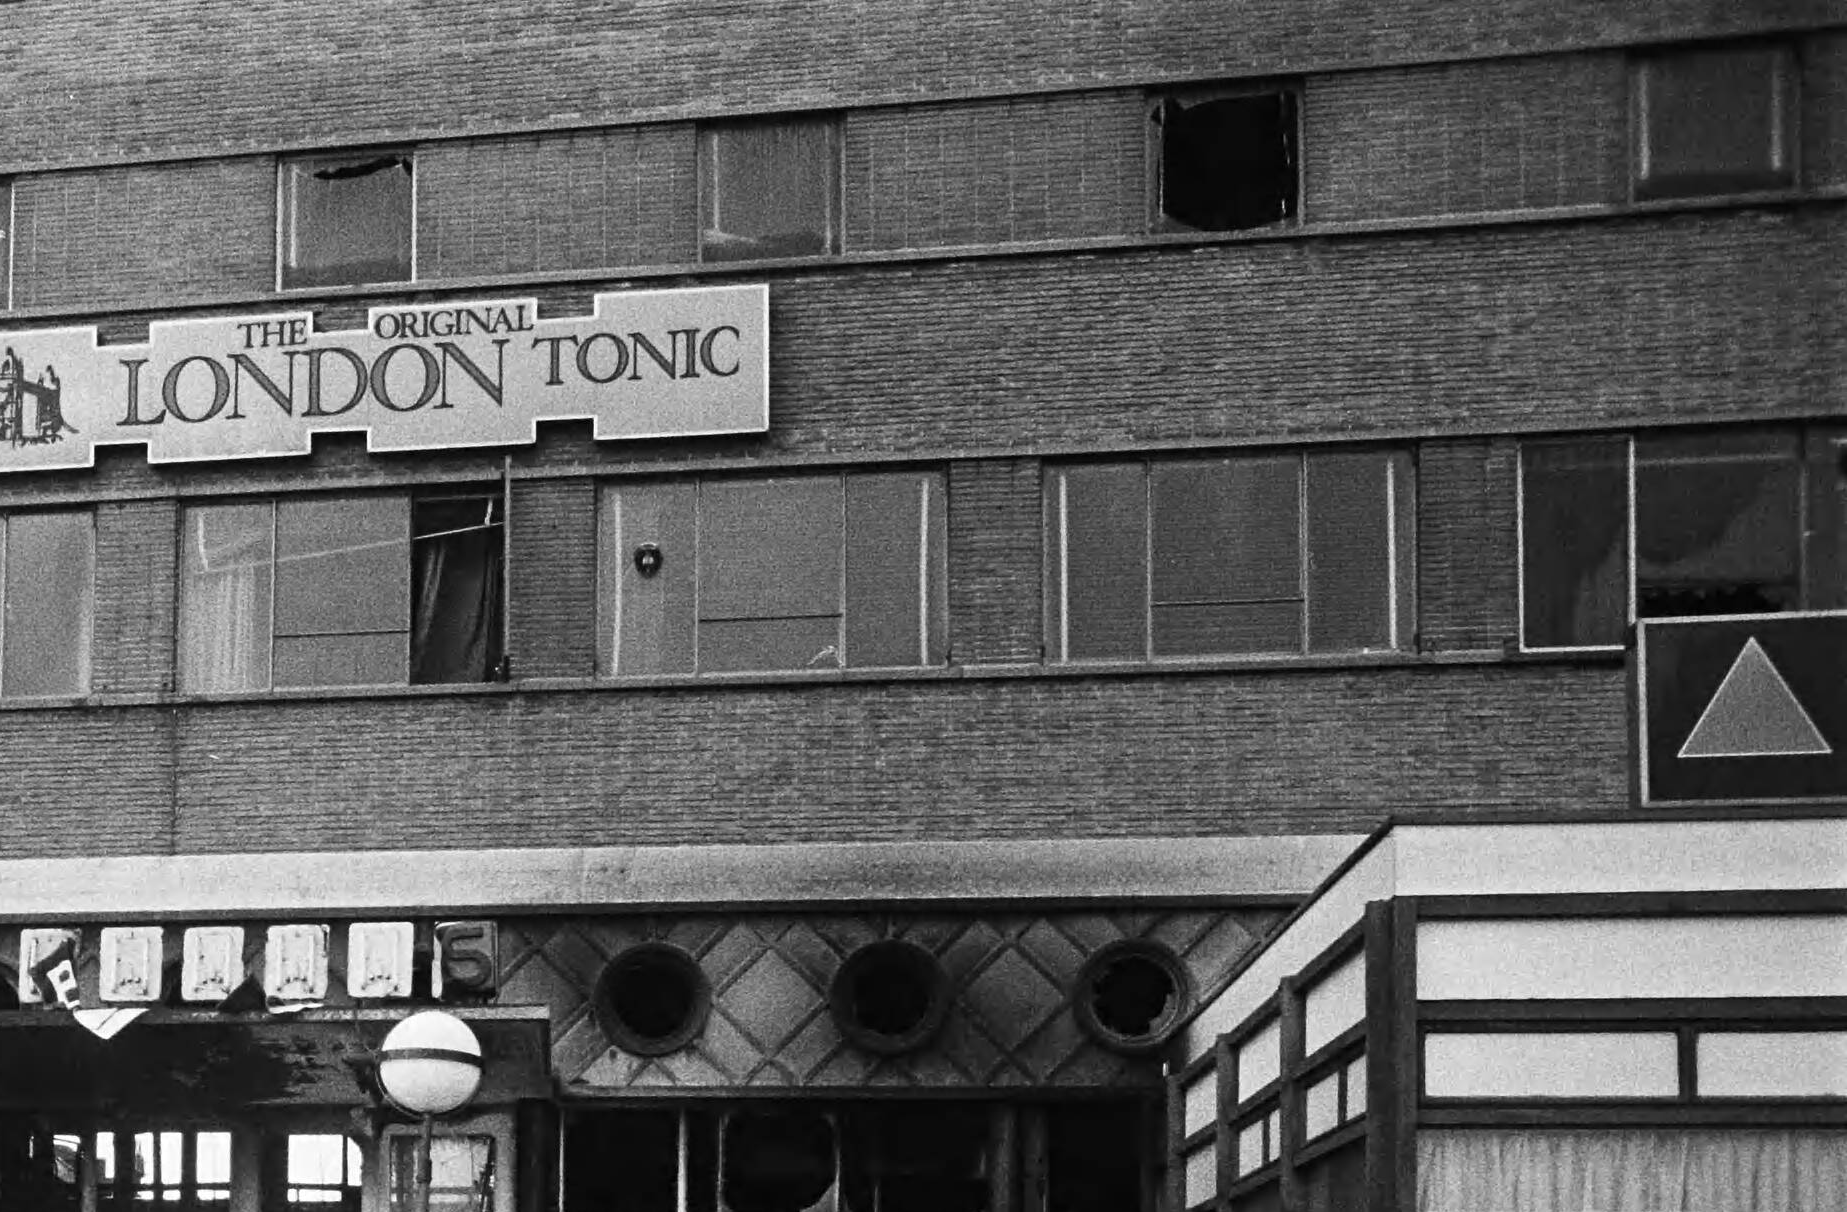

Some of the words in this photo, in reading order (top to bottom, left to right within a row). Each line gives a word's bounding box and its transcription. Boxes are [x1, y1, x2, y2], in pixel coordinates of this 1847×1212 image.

[237, 318, 308, 348] THE
[373, 305, 535, 339] ORIGINAL
[116, 338, 511, 426] LONDON
[530, 324, 741, 386] TONIC
